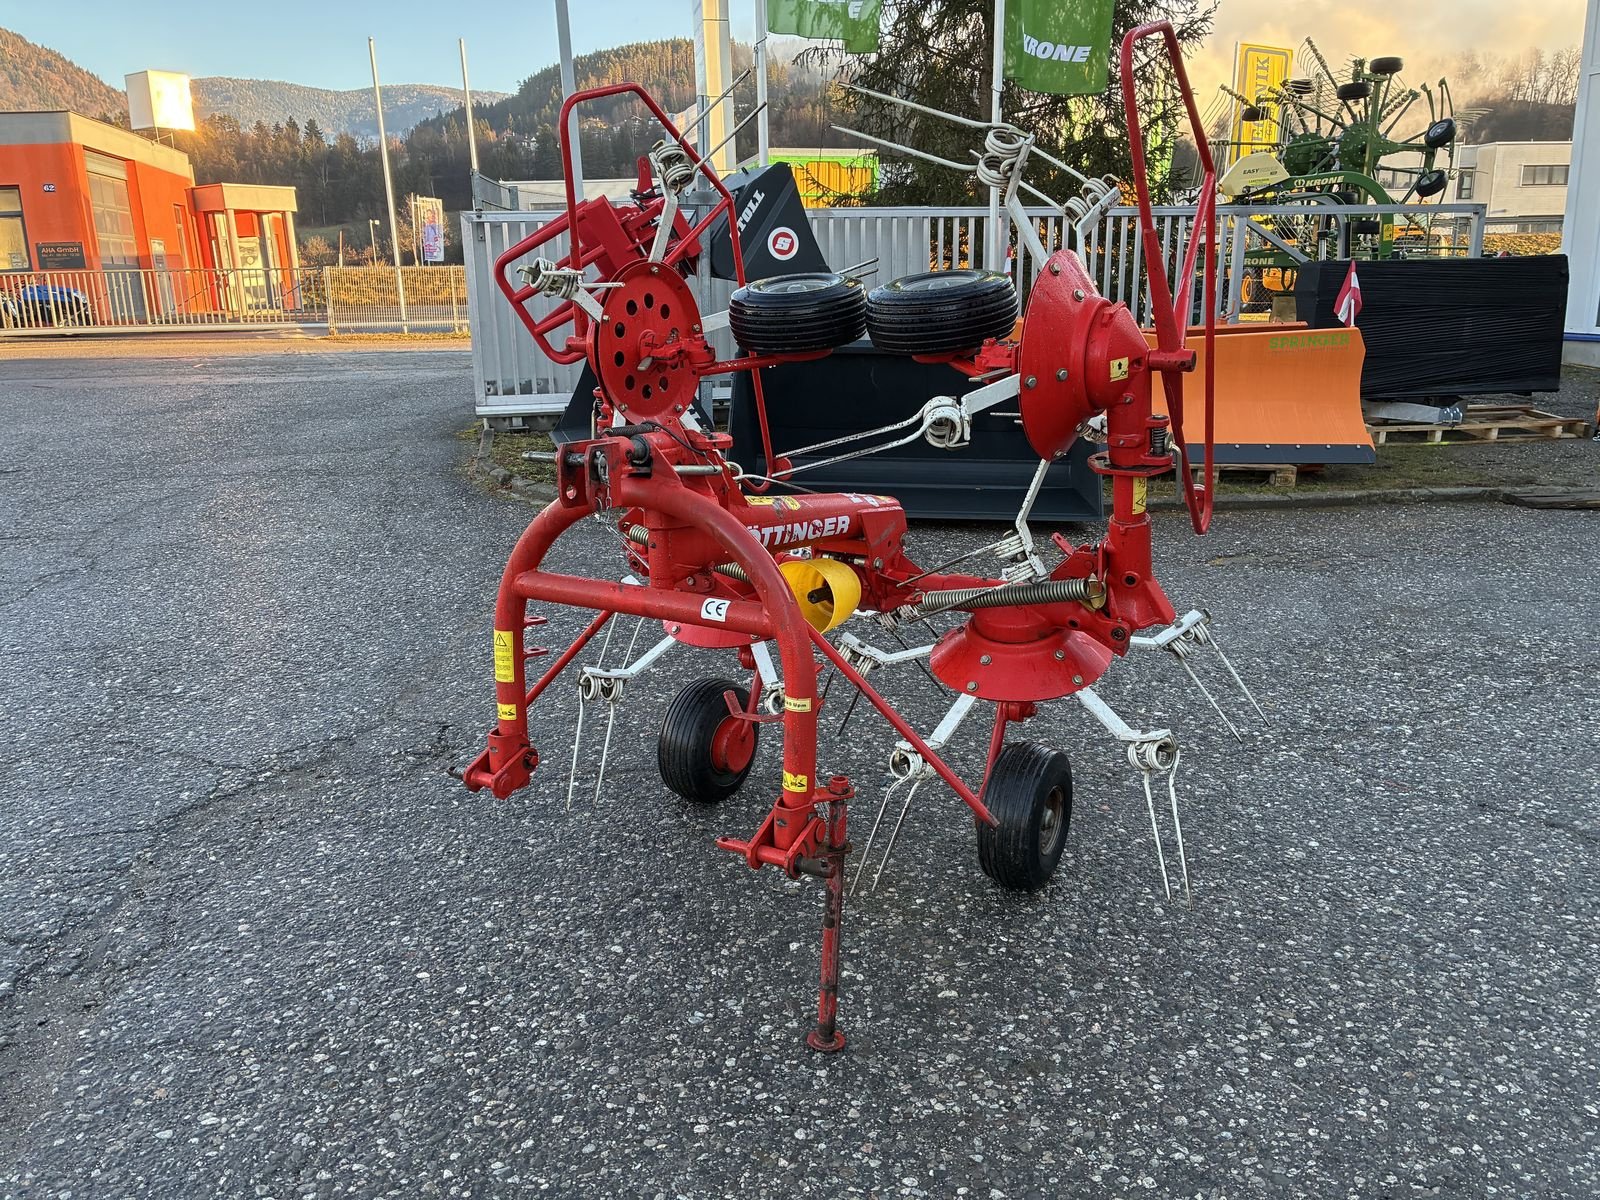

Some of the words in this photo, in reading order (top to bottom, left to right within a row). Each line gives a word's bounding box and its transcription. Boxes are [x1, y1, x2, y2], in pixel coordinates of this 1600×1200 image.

[43, 184, 55, 192] 62
[1306, 176, 1345, 187] KRONE
[731, 189, 765, 238] TOLL
[1243, 257, 1275, 265] RONE
[1268, 333, 1350, 349] SPRINGER
[747, 515, 850, 548] ÖTTINGER
[705, 600, 726, 617] CE
